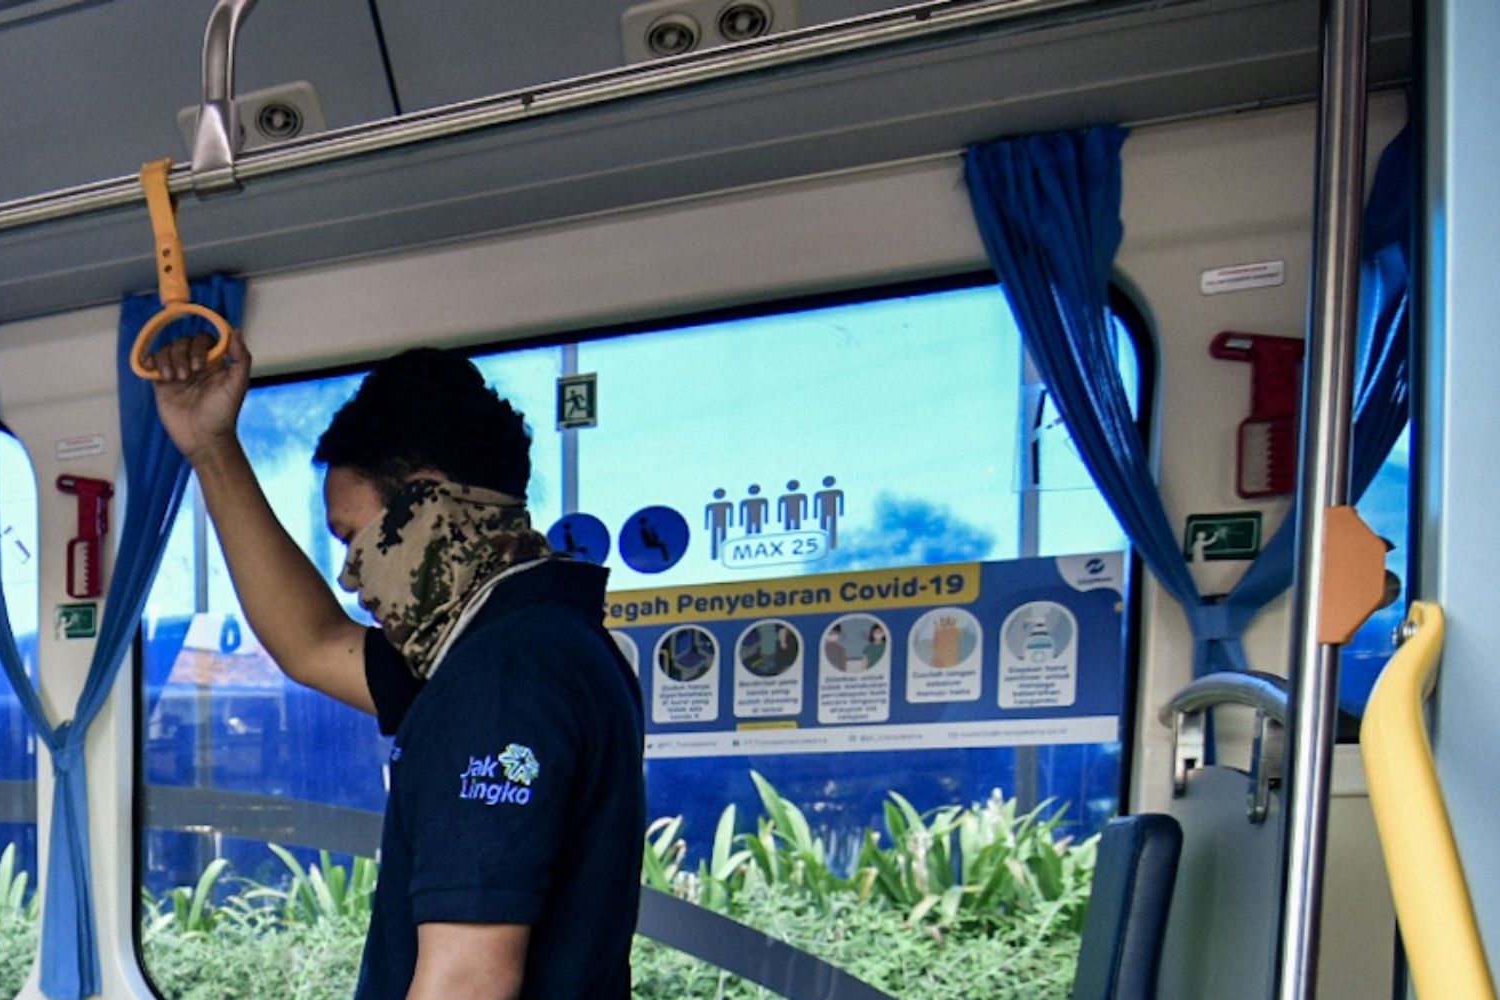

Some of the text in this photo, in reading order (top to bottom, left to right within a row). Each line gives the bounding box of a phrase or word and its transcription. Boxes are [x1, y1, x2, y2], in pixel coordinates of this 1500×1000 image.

[732, 537, 819, 561] MAX 25
[676, 584, 833, 616] Penyebaran
[839, 573, 966, 602] Covid-19
[459, 777, 532, 806] Lingko
